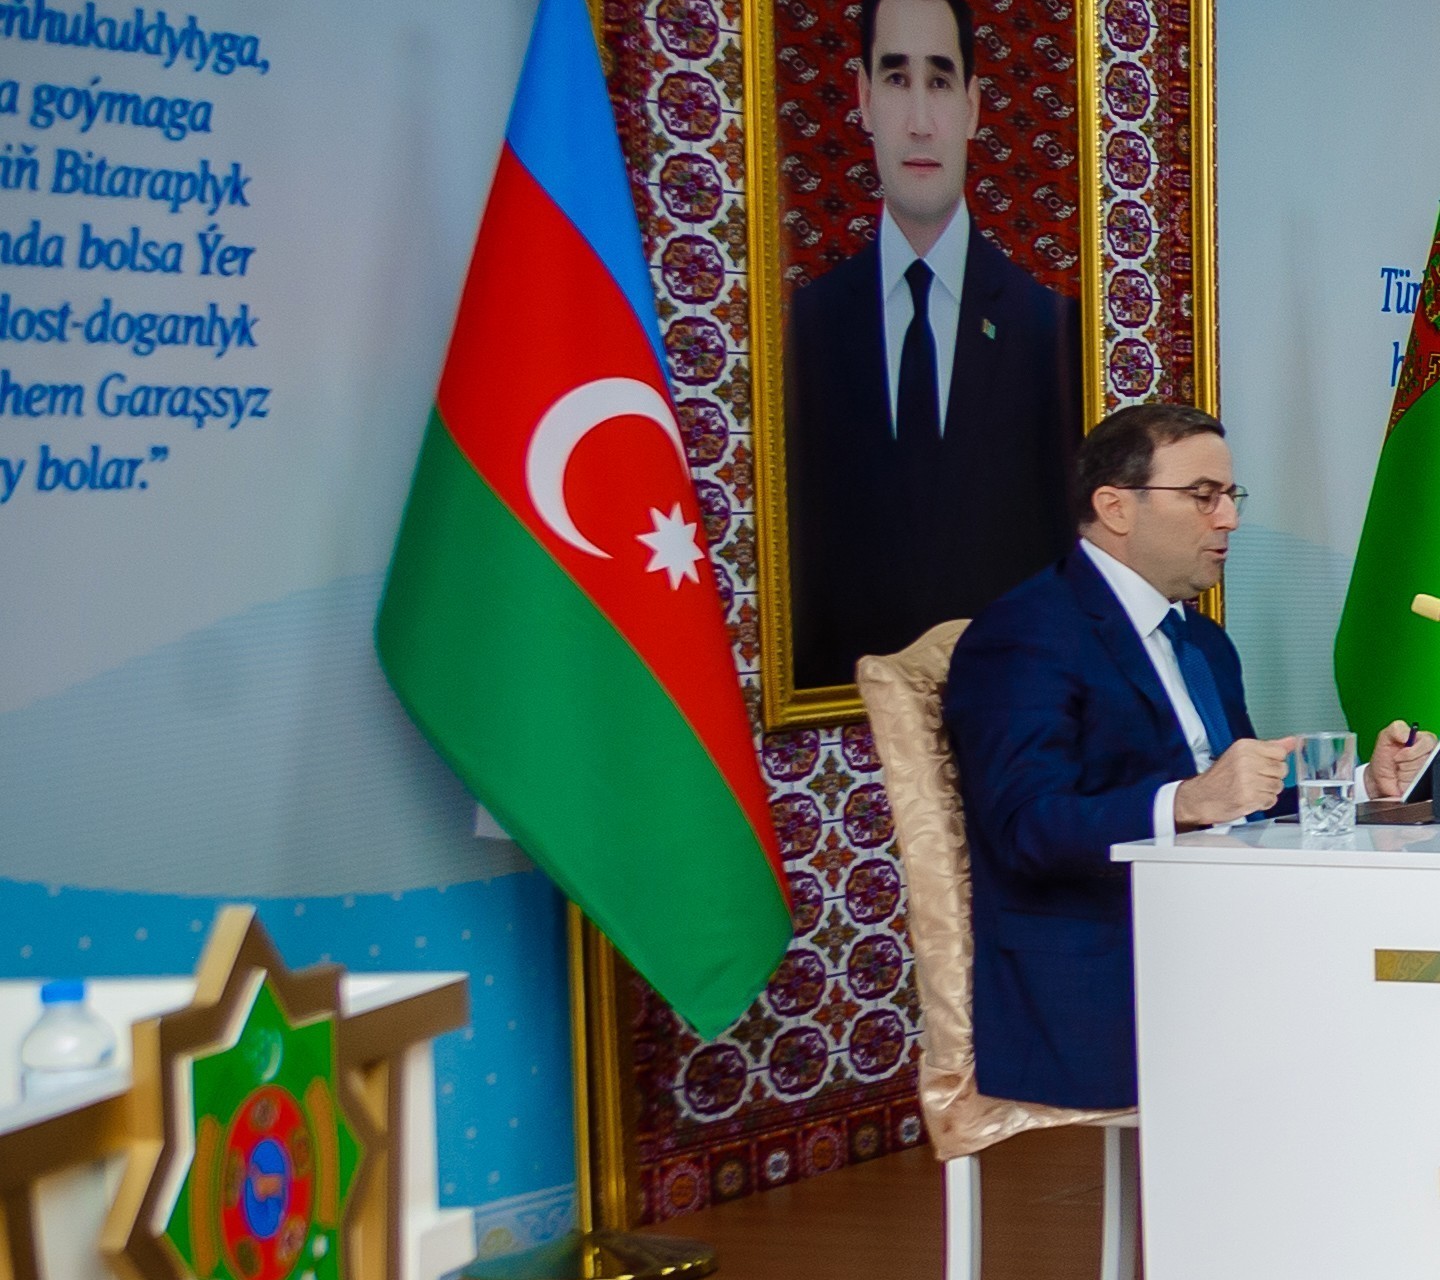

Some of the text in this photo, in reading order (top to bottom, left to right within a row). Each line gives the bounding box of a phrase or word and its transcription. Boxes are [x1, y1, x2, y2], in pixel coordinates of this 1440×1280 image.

[30, 75, 213, 140] goýmaga
[51, 147, 251, 216] Bitaraplyk
[79, 223, 182, 275] bolsa
[197, 223, 255, 277] Ýer
[0, 368, 271, 428] hem Garaşsyz
